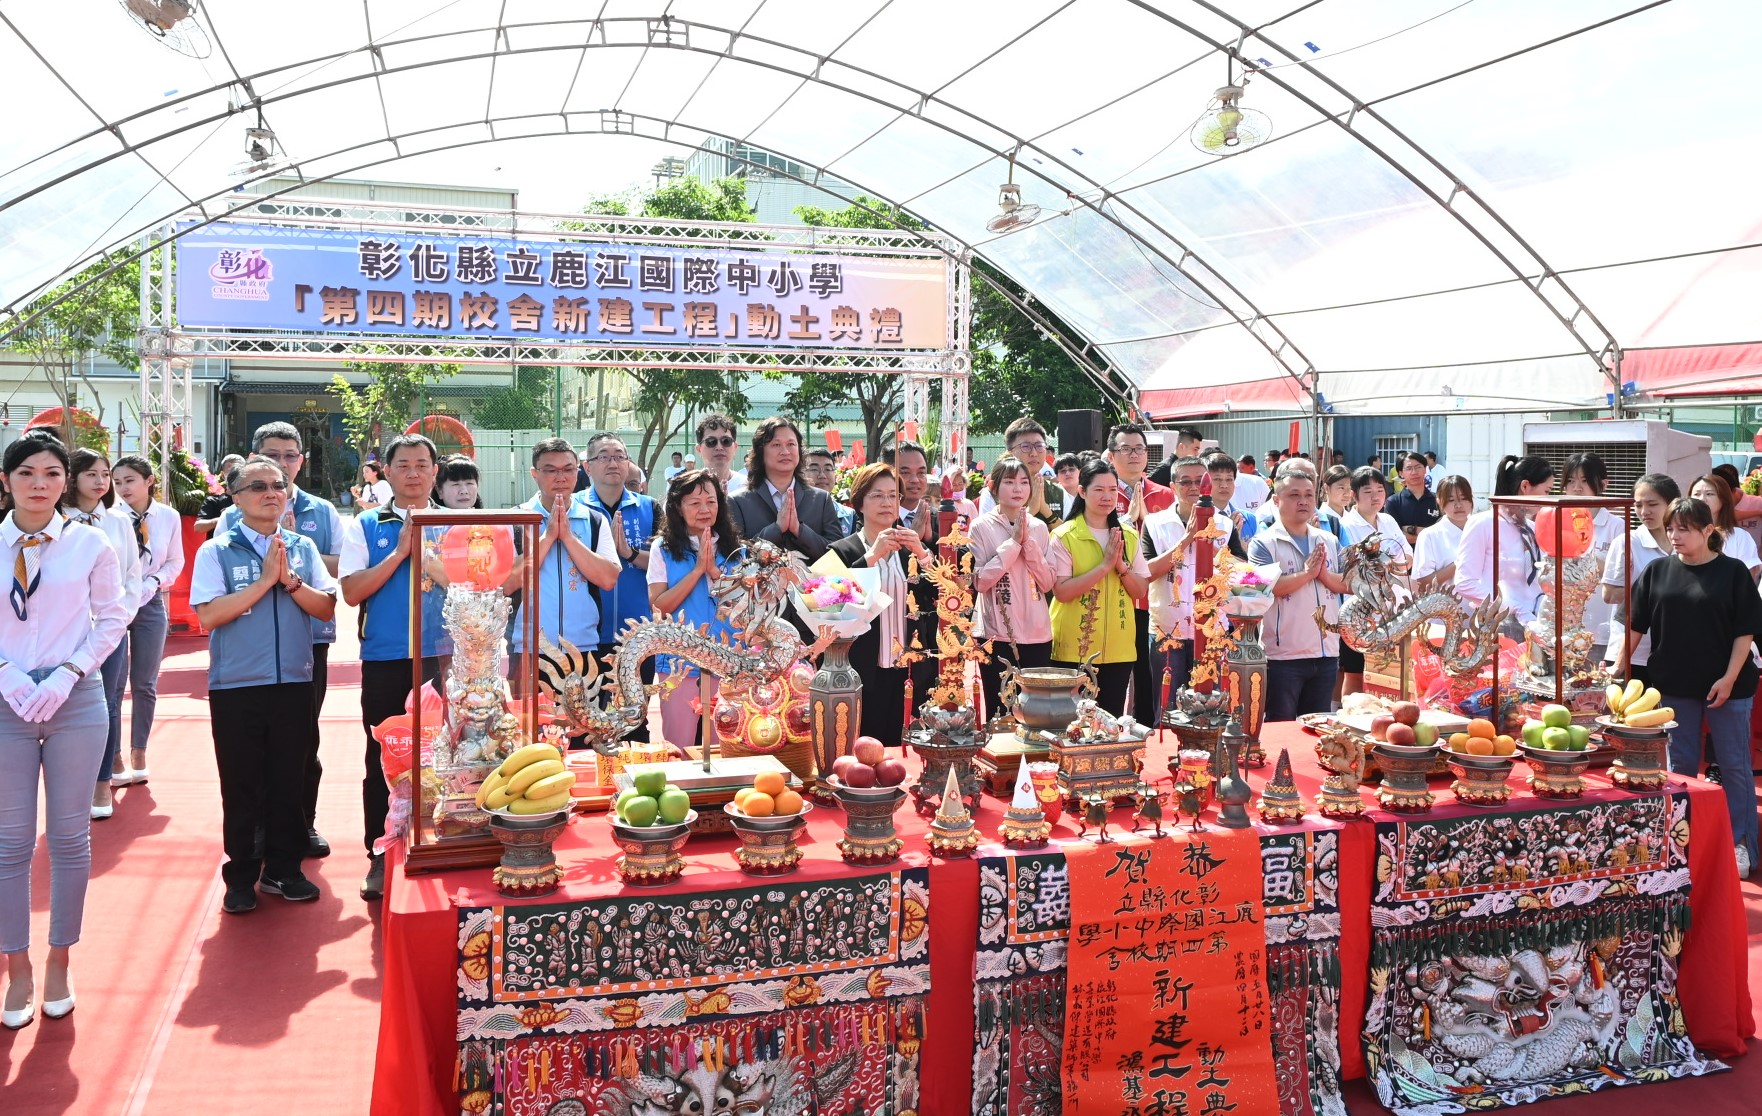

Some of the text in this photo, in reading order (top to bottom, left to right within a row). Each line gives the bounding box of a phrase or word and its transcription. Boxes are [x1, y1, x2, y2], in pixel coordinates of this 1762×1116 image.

[213, 287, 267, 295] CHANGHUA
[359, 239, 843, 298] 彰化縣立鹿江國際中小學
[294, 283, 903, 343] 「第四期校舍新建工程」動土典禮
[1113, 881, 1221, 916] 彰化縣立
[1095, 930, 1229, 971] 第四期校舍
[1195, 1042, 1238, 1116] 動土典
